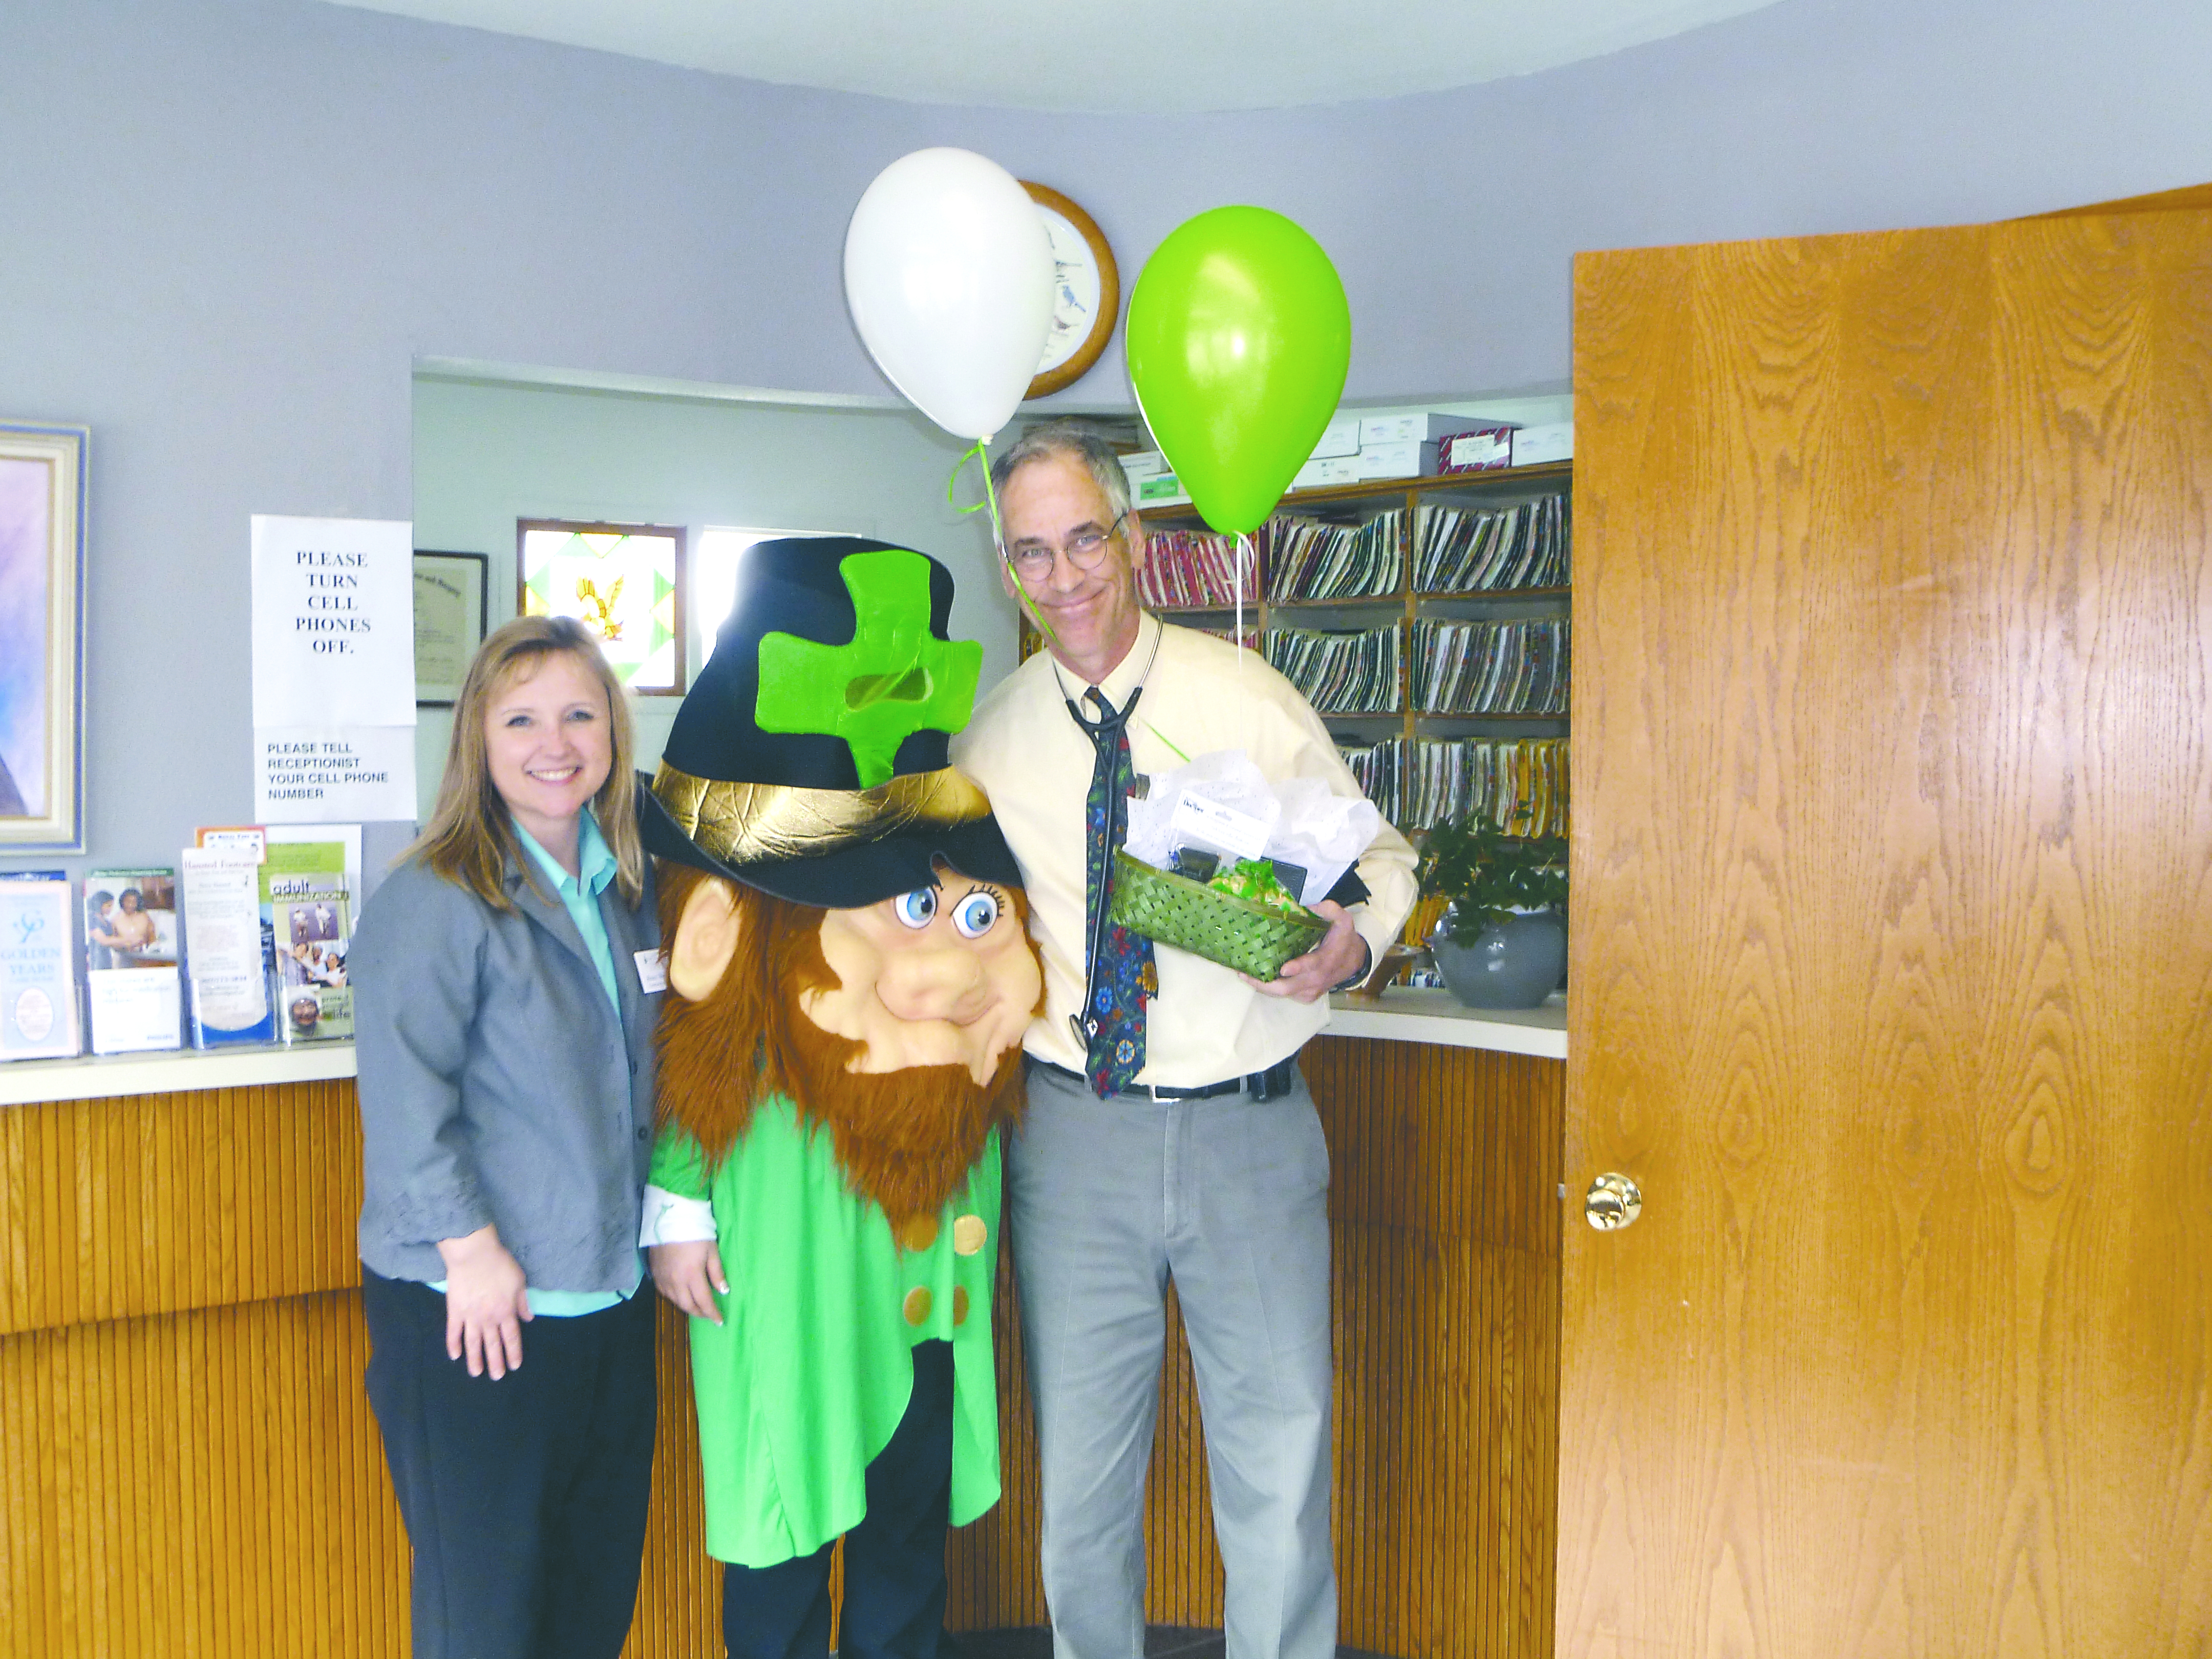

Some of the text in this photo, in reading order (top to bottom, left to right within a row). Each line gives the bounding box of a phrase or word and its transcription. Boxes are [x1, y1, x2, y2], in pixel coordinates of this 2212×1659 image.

[297, 551, 368, 568] PLEASE
[306, 573, 358, 589] TURN
[308, 596, 358, 611] CELL
[296, 618, 372, 633] PHONES
[312, 640, 355, 655] OFF.
[268, 742, 353, 755] PLEASE TELL
[268, 757, 361, 770] RECEPTIONIST
[269, 772, 389, 785] YOUR CELL PHONE
[268, 788, 325, 801] NUMBER
[273, 879, 309, 895] adult
[1, 948, 61, 959] GOLDEN
[9, 963, 55, 974] YEARS
